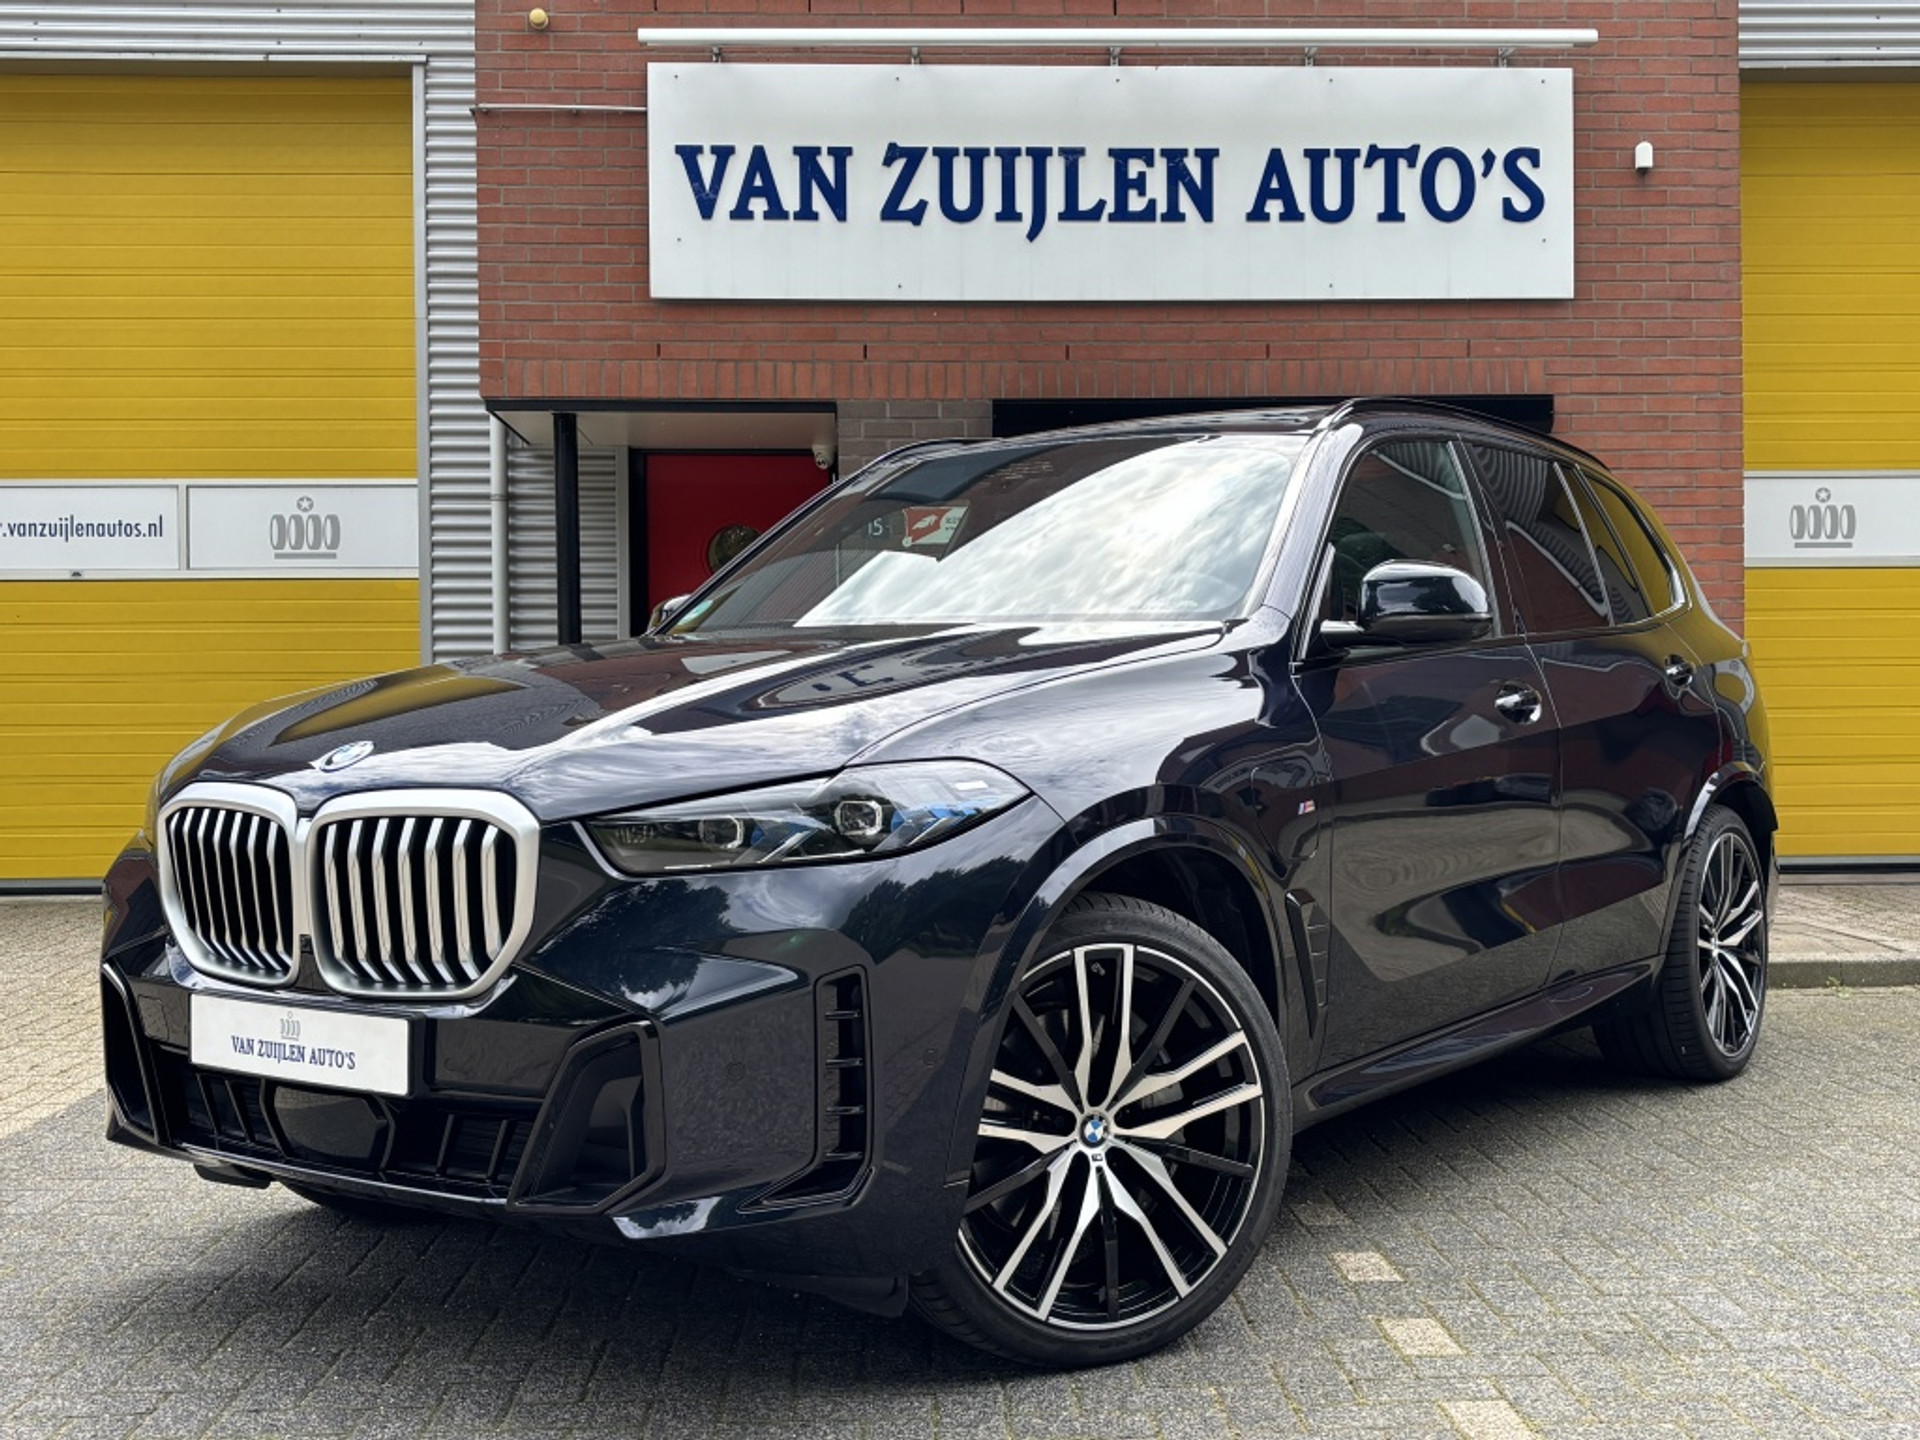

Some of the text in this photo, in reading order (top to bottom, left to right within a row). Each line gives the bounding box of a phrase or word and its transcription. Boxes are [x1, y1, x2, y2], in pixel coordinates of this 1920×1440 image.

[674, 142, 1546, 243] VAN ZUIJLEN AUTO'S
[0, 514, 163, 543] .vanzuijlenautos.nl
[231, 1035, 356, 1070] VAN ZUIJLEN AUTO'S
